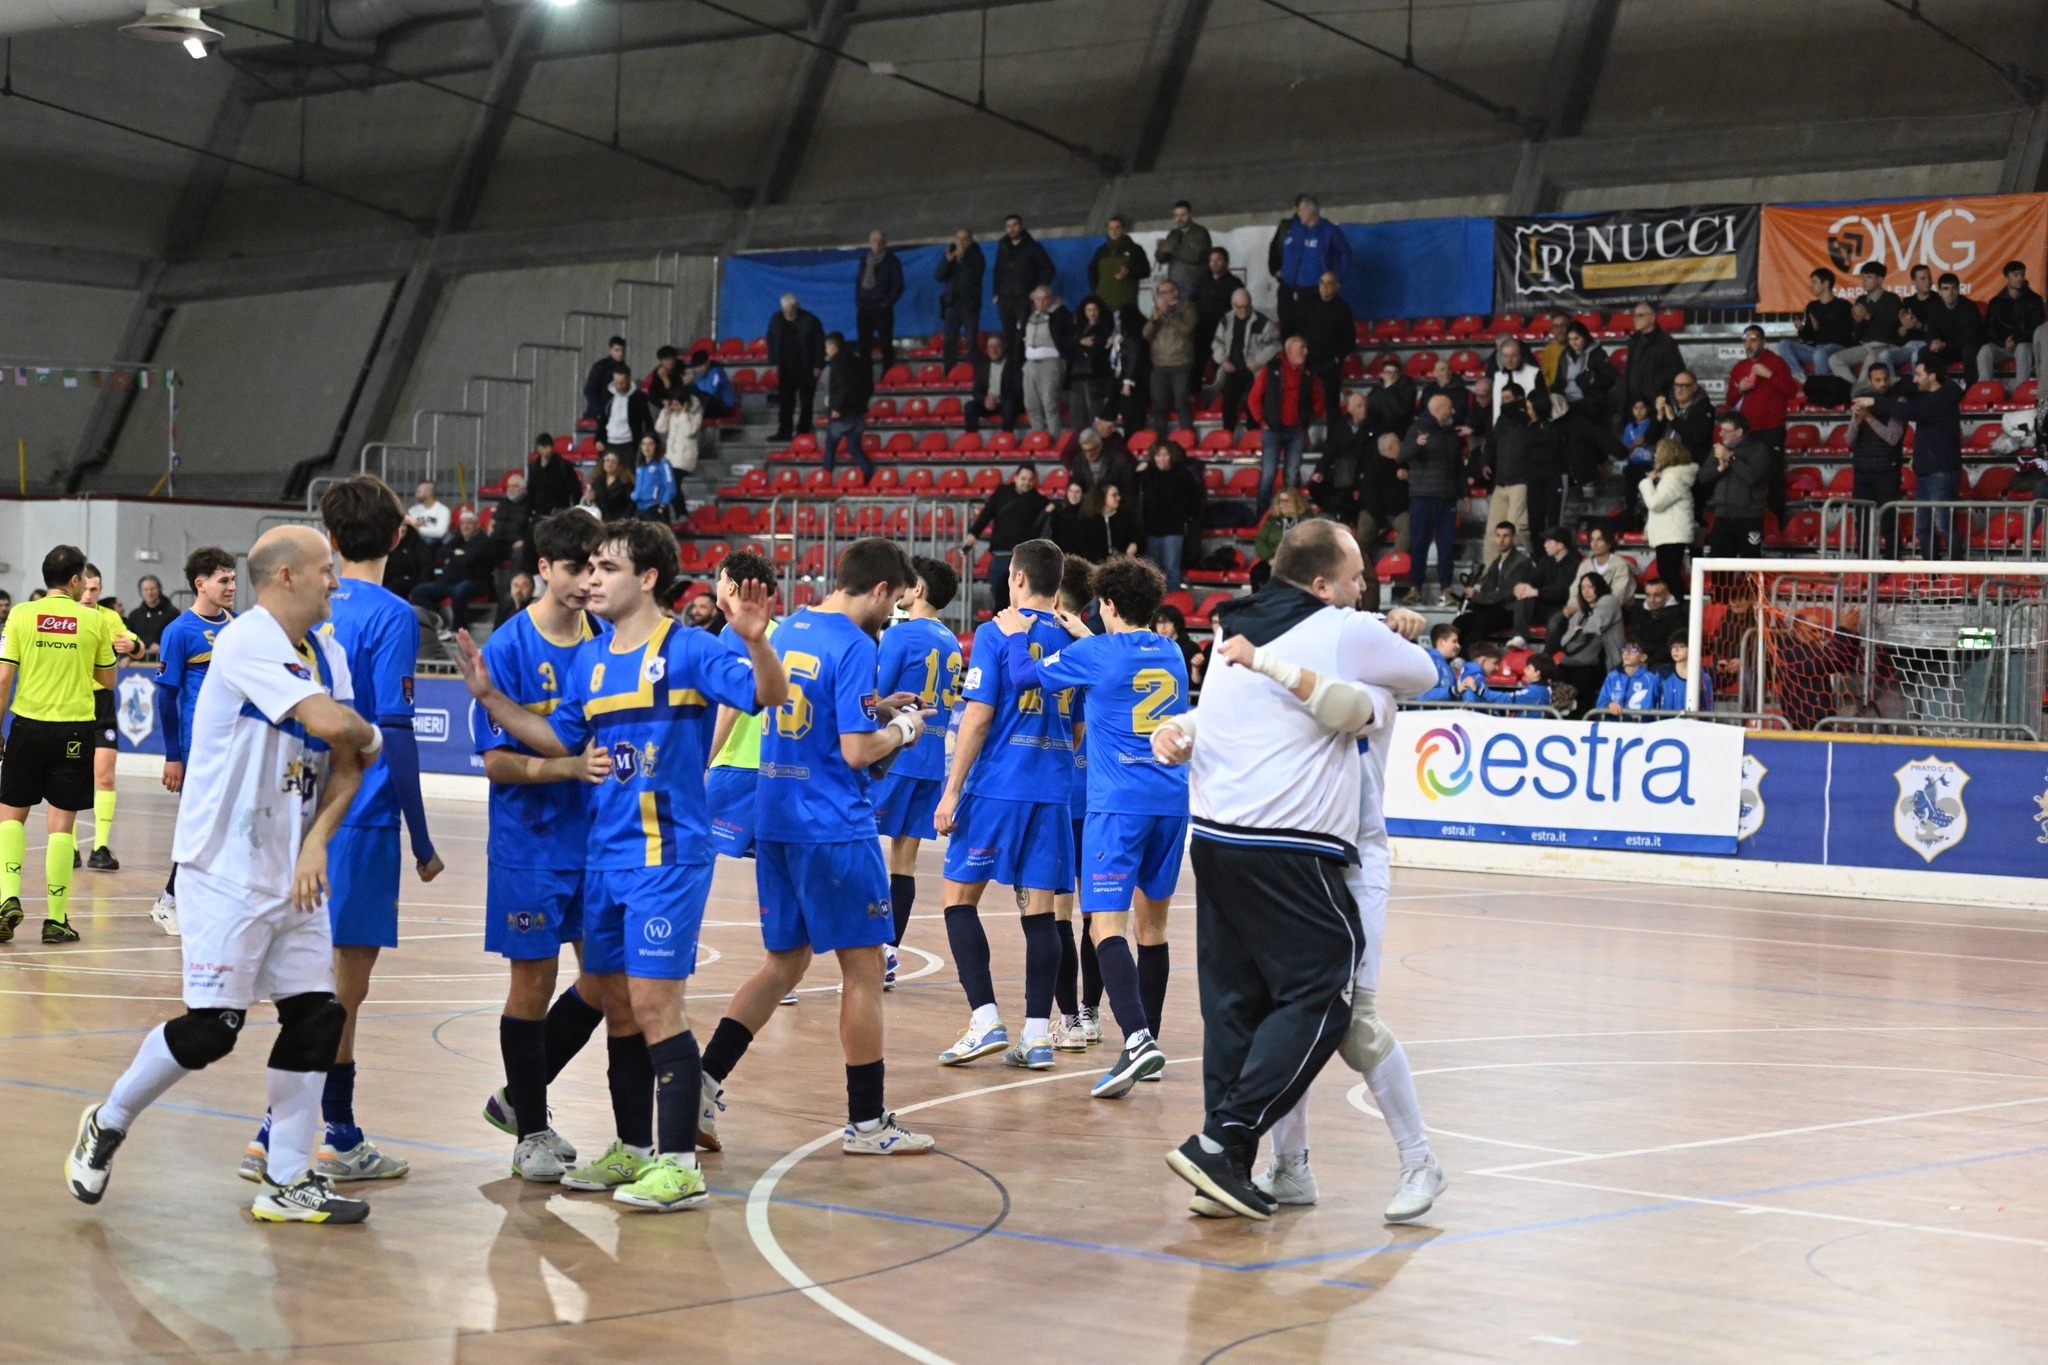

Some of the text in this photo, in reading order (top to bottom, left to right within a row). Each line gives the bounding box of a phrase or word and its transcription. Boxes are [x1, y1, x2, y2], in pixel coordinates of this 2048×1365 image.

[1584, 215, 1737, 264] NUCCI
[37, 616, 77, 631] Lete
[36, 640, 77, 650] GIVOVA
[538, 662, 557, 692] 3
[590, 663, 606, 693] 8
[920, 648, 963, 711] 13
[761, 650, 822, 740] 5
[1132, 668, 1179, 738] 2
[411, 715, 444, 734] HIERI
[616, 753, 632, 770] M
[1480, 722, 1695, 805] estra
[1910, 764, 1936, 772] PRATO
[1441, 825, 1661, 848] estra.it estra.it estra.it
[638, 947, 675, 958] Woodland
